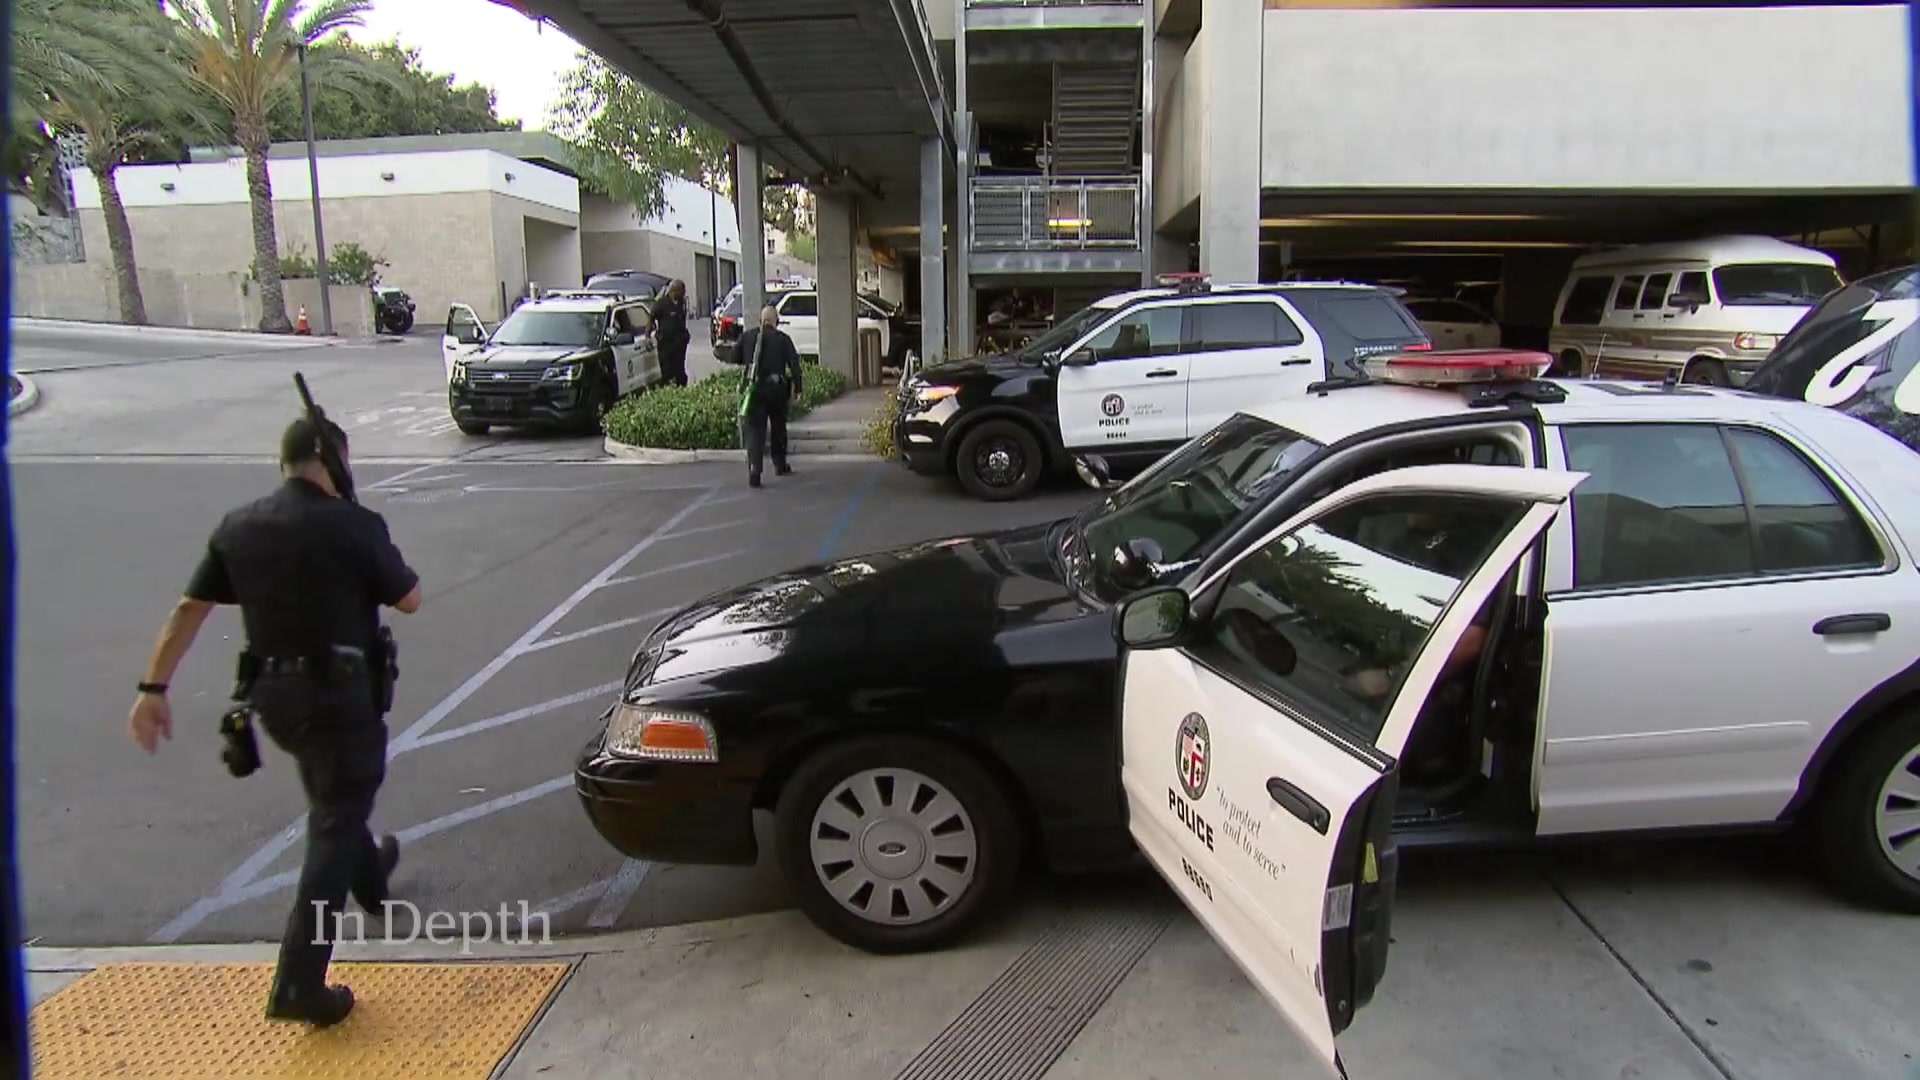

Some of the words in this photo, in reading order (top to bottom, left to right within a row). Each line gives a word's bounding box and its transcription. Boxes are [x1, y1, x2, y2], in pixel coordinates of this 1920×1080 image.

[1098, 417, 1130, 428] POLICE
[1168, 786, 1215, 853] POLICE
[1222, 820, 1242, 847] and
[1242, 833, 1253, 856] to
[1228, 802, 1262, 840] protect
